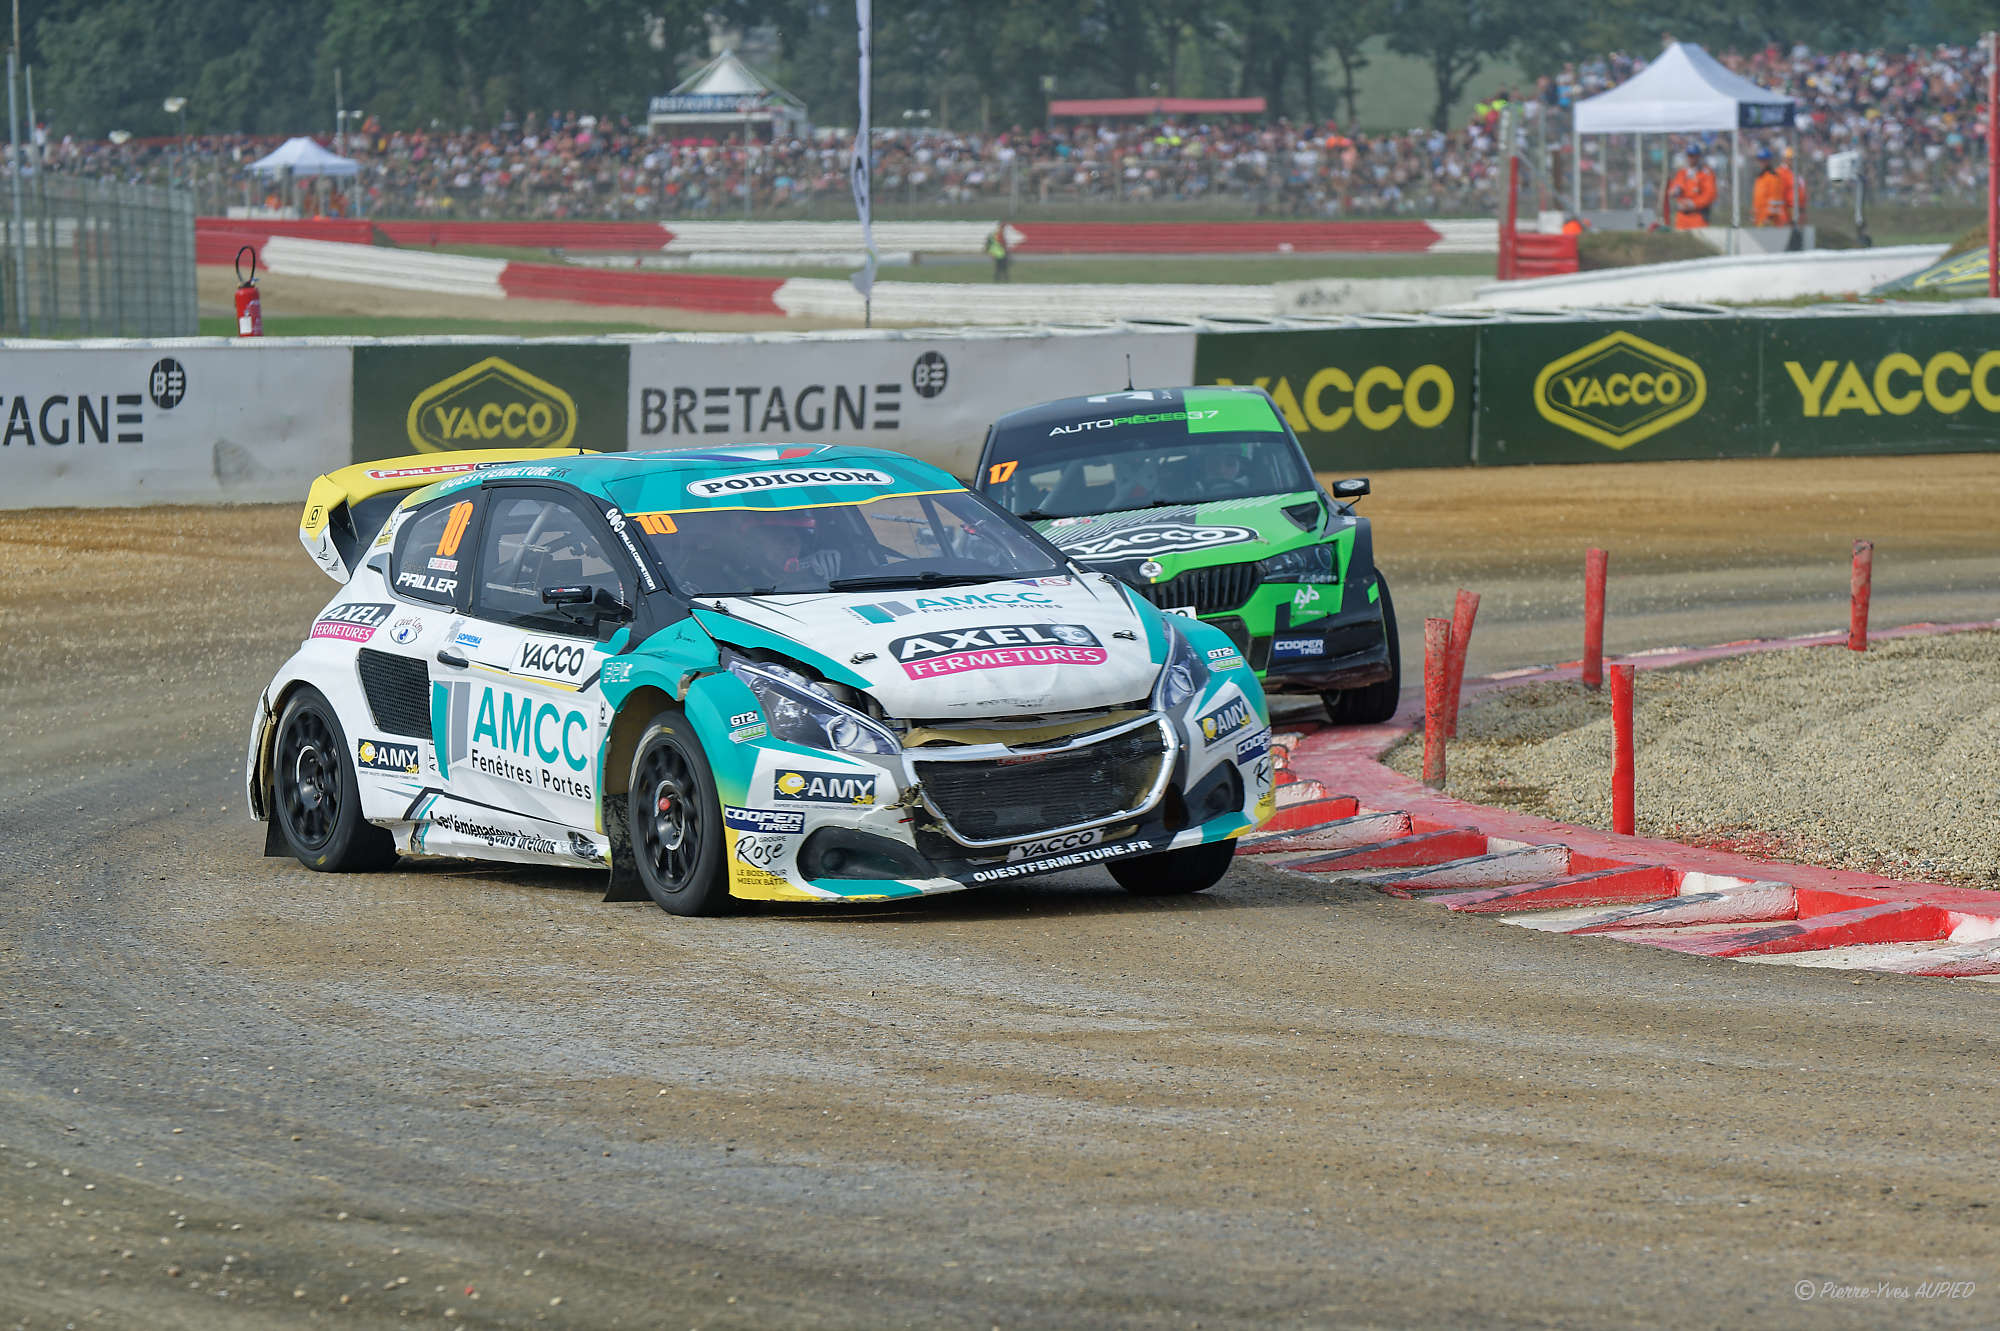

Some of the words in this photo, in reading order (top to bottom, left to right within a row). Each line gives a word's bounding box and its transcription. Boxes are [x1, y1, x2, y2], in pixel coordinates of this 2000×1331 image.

[1562, 371, 1682, 407] YACCO
[1784, 350, 2000, 417] YACCO
[641, 384, 902, 435] BRETAGNE
[1216, 364, 1455, 432] ACCO
[0, 394, 143, 446] AGNE
[434, 402, 553, 440] YACCO
[701, 472, 882, 494] PODIOCOM
[989, 460, 1019, 485] 17
[436, 501, 474, 556] 10
[633, 514, 679, 535] 10
[1075, 529, 1226, 554] YACCO
[396, 573, 458, 598] PAILLER
[916, 592, 1053, 609] AMCC
[313, 623, 373, 642] FERMETURES
[899, 626, 1059, 660] AXEL
[1275, 639, 1324, 651] COOPER
[520, 642, 585, 677] YACCO
[911, 648, 1101, 676] FERMETURES
[472, 686, 589, 772] AMCC
[1217, 701, 1246, 734] AMY
[377, 746, 417, 768] AMY
[472, 748, 533, 784] Fenêtres
[542, 769, 592, 800] Portes
[807, 777, 874, 799] AMY
[724, 806, 802, 824] COOPER
[757, 822, 802, 832] TIRES
[734, 835, 783, 869] Rose
[1020, 831, 1095, 858] YACCO
[746, 869, 764, 877] BOIS
[766, 869, 787, 877] POUR
[973, 840, 1152, 882] OUESTFERMETURE.FR
